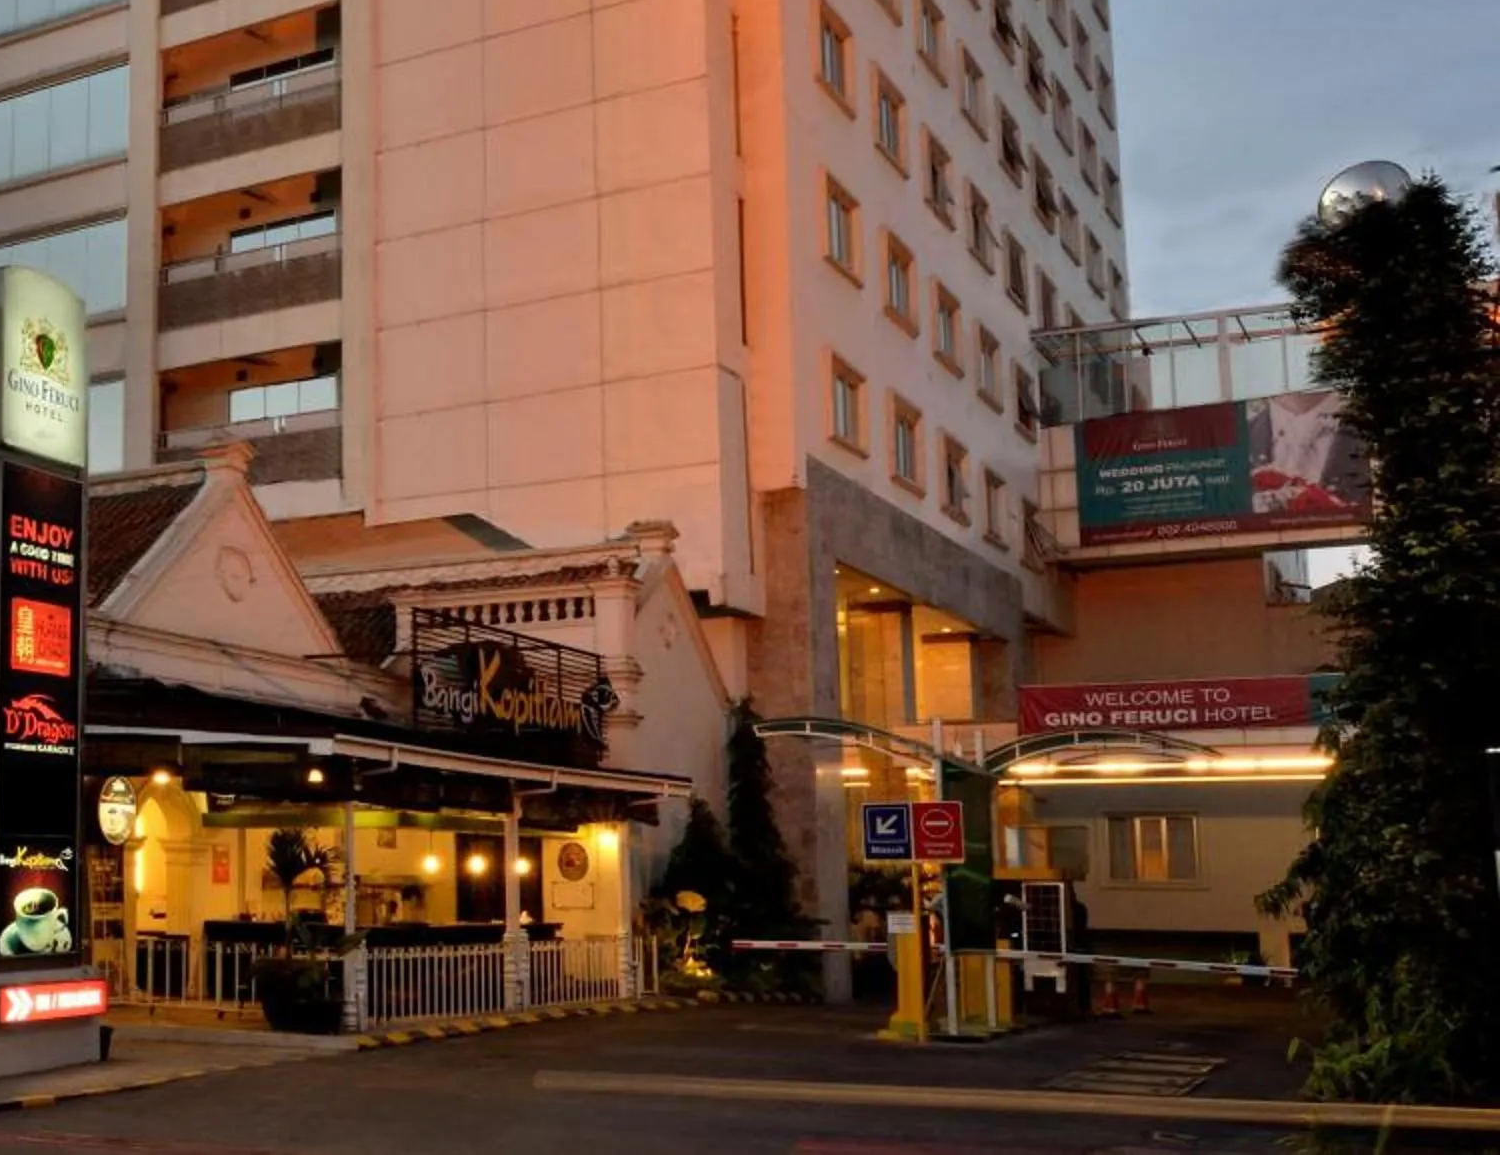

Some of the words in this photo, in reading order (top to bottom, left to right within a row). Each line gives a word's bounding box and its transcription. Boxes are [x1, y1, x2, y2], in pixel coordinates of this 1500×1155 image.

[8, 368, 39, 397] GINO
[25, 402, 69, 423] HOTEL
[1099, 464, 1163, 478] WEDDING
[1121, 480, 1145, 494] 20
[1148, 475, 1200, 491] JUTA
[10, 514, 73, 549] ENJOY
[10, 540, 18, 553] A
[9, 556, 47, 581] WITH
[51, 567, 74, 585] US
[419, 660, 479, 724] Bangi
[478, 648, 582, 736] Kopitiam
[1085, 689, 1194, 707] WELCOME
[1200, 688, 1230, 703] TO
[3, 707, 75, 744] D'Dragon
[1045, 711, 1101, 727] GINO
[1110, 708, 1197, 725] FERUCI
[1203, 705, 1276, 722] HOTEL
